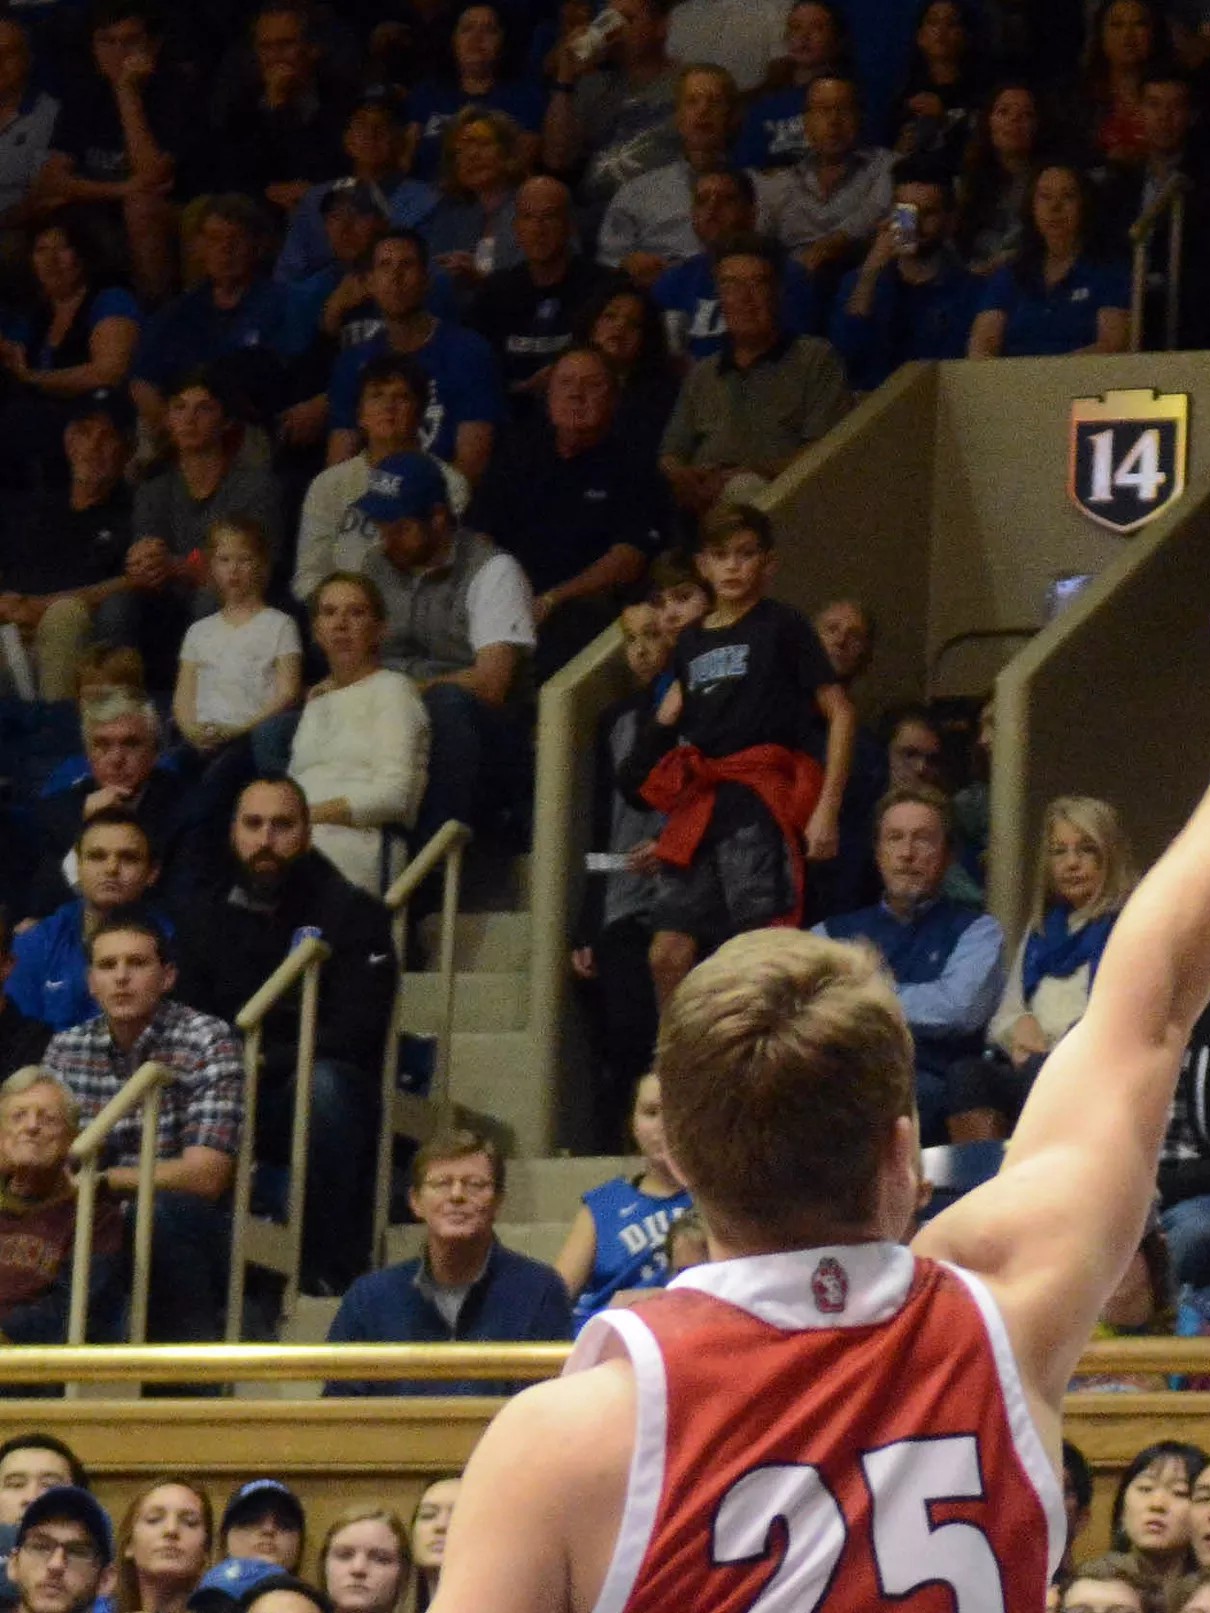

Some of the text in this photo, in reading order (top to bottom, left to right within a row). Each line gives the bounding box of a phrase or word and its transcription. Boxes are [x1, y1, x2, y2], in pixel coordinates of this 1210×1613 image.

[1086, 428, 1167, 502] 14
[618, 1207, 685, 1257] DU
[709, 1434, 1008, 1613] 25
